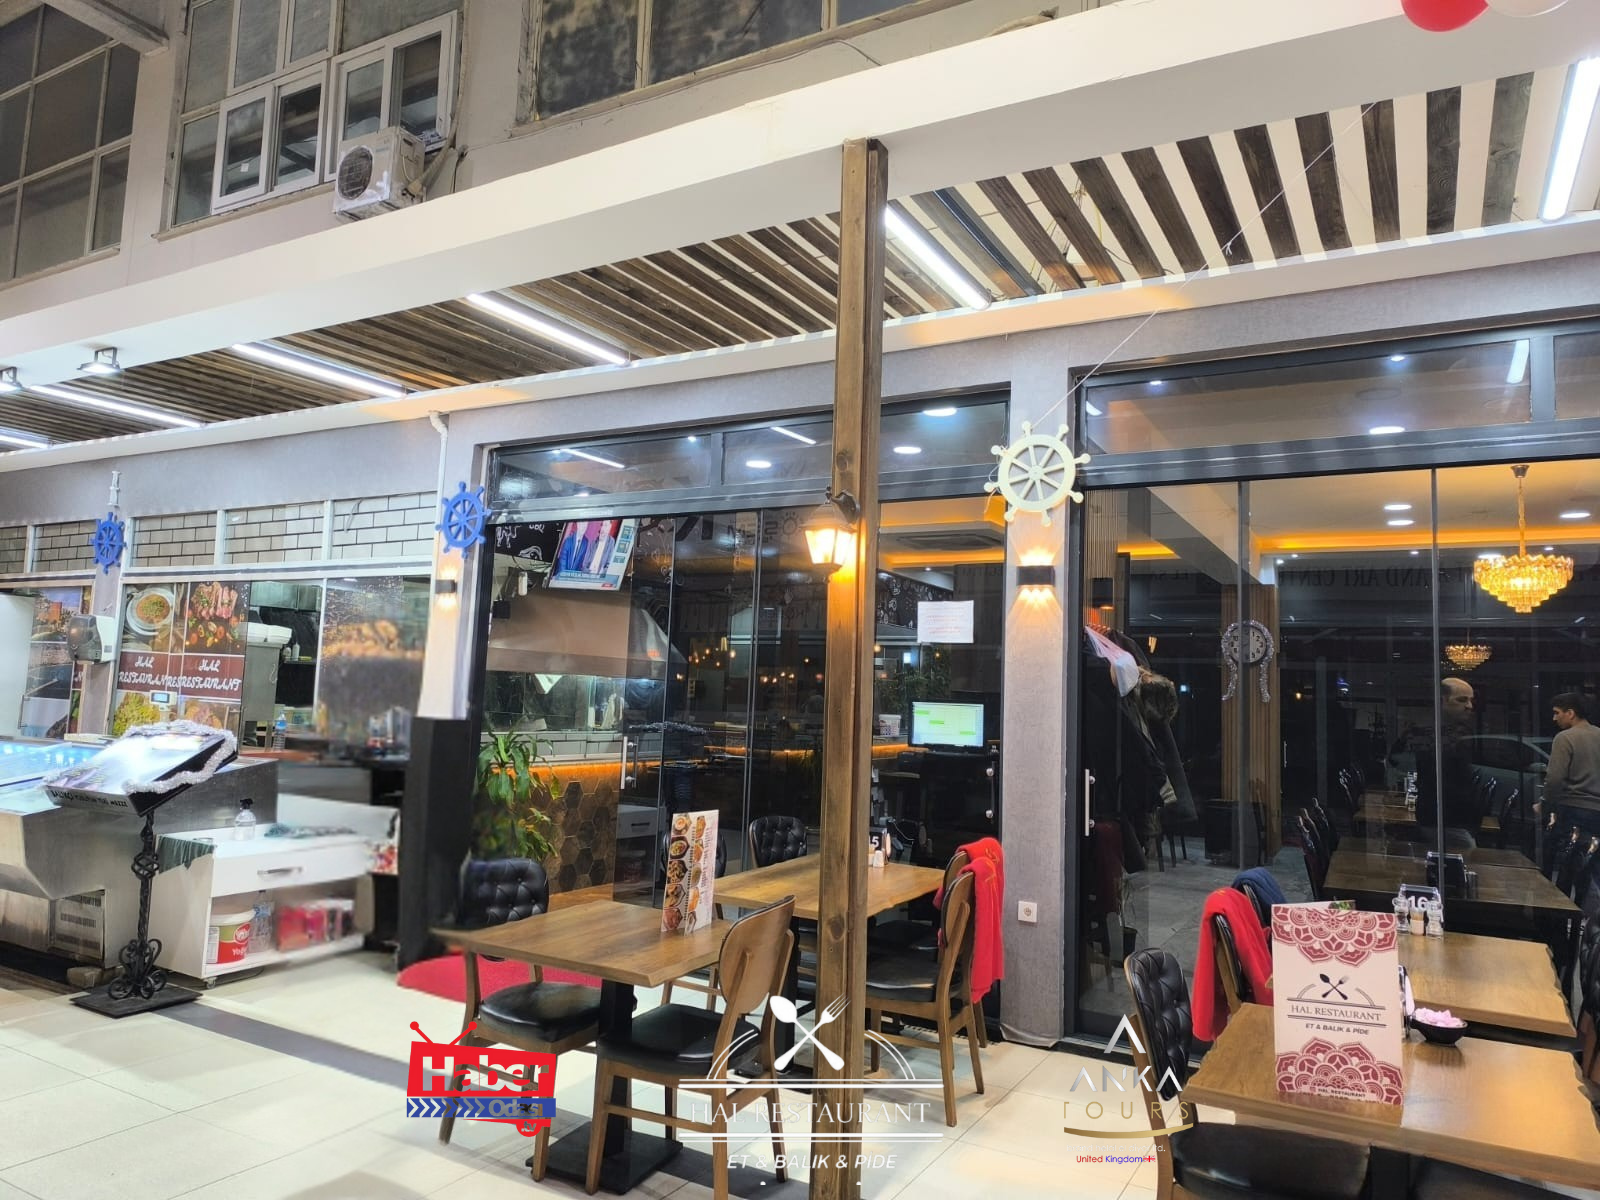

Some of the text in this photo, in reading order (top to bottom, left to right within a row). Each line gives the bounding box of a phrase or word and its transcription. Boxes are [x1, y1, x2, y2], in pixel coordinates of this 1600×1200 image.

[135, 656, 155, 668] HAL
[198, 659, 221, 672] HAL
[180, 676, 242, 691] RESTAURANT
[1407, 895, 1429, 911] 16
[1291, 1004, 1381, 1021] HAL RESTAURANT
